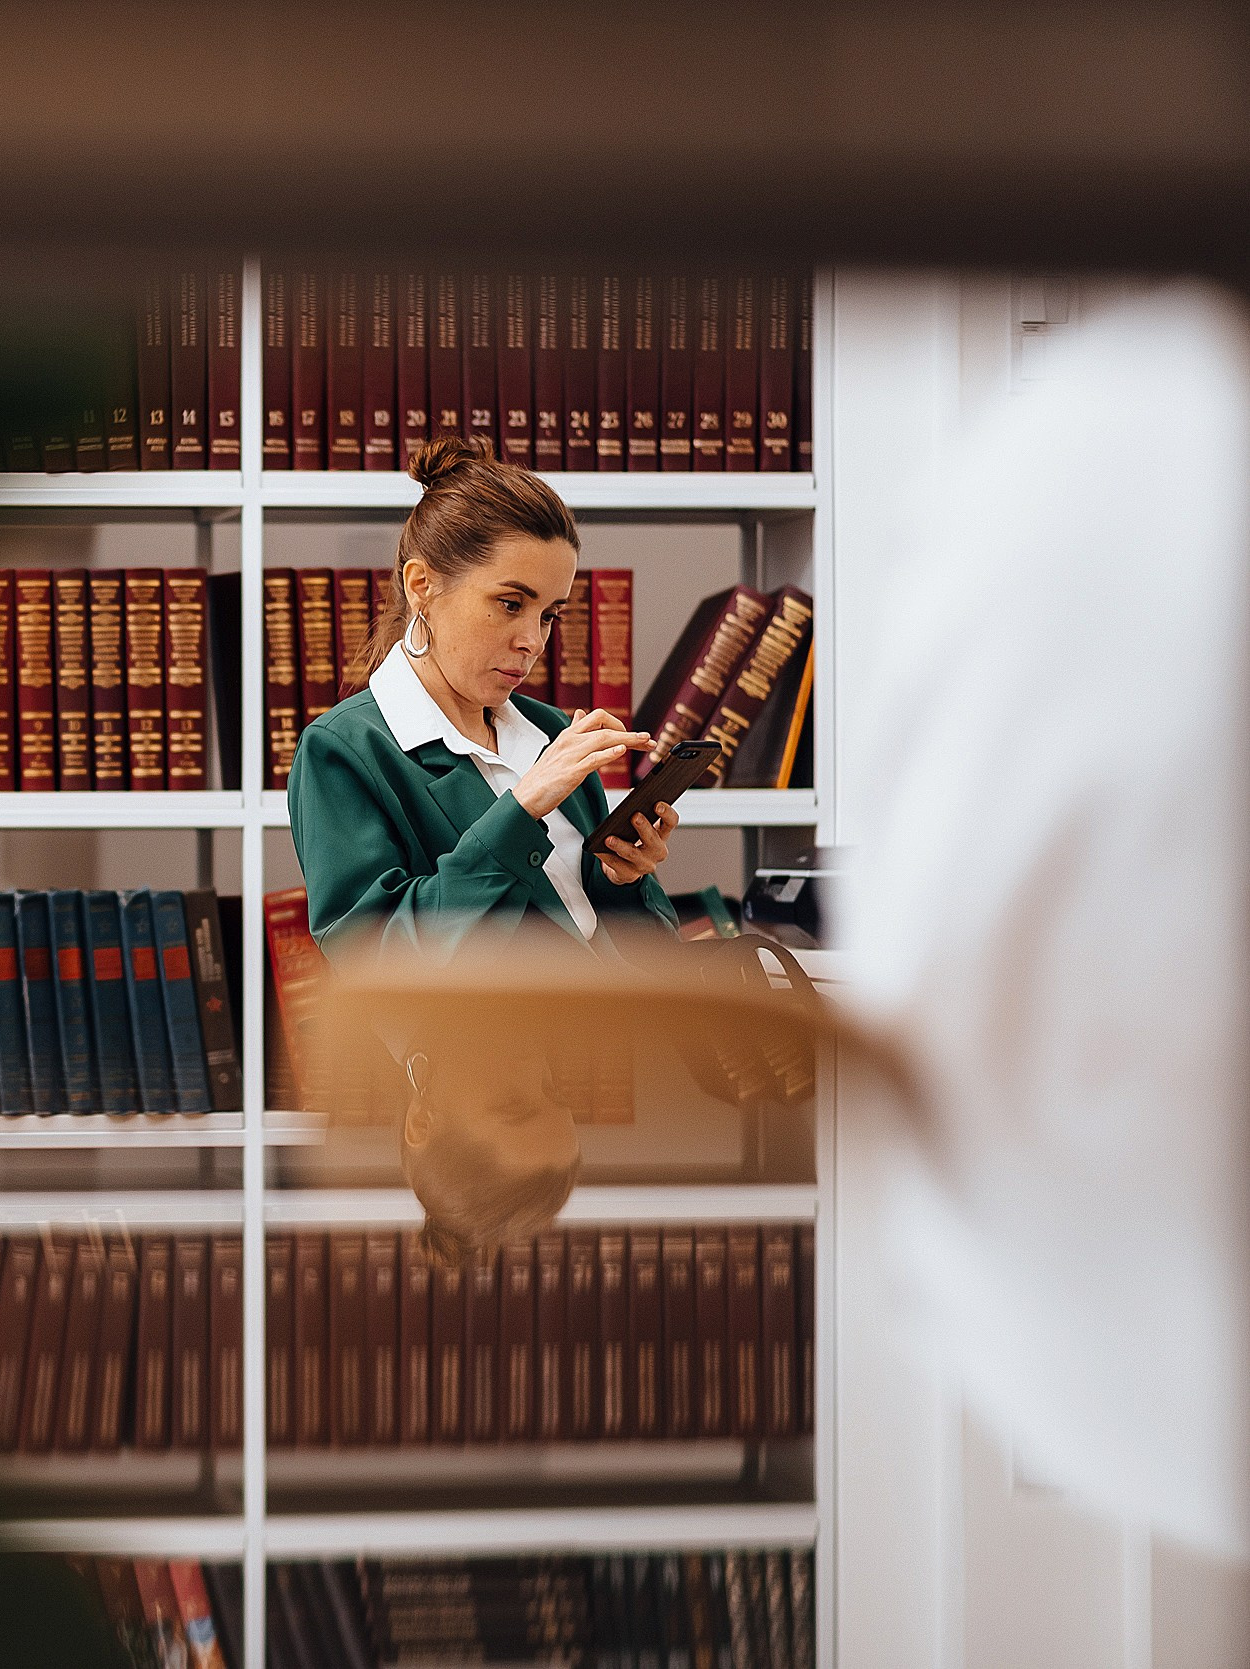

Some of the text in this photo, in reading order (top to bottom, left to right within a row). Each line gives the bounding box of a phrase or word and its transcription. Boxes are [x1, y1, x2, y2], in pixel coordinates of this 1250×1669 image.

[112, 408, 128, 424] 12
[149, 409, 165, 426] 13
[301, 410, 316, 426] 17
[406, 410, 426, 427] 20
[471, 409, 492, 426] 22
[667, 411, 687, 429] 27
[766, 411, 788, 429] 30
[67, 720, 81, 732] 10
[140, 719, 154, 731] 12
